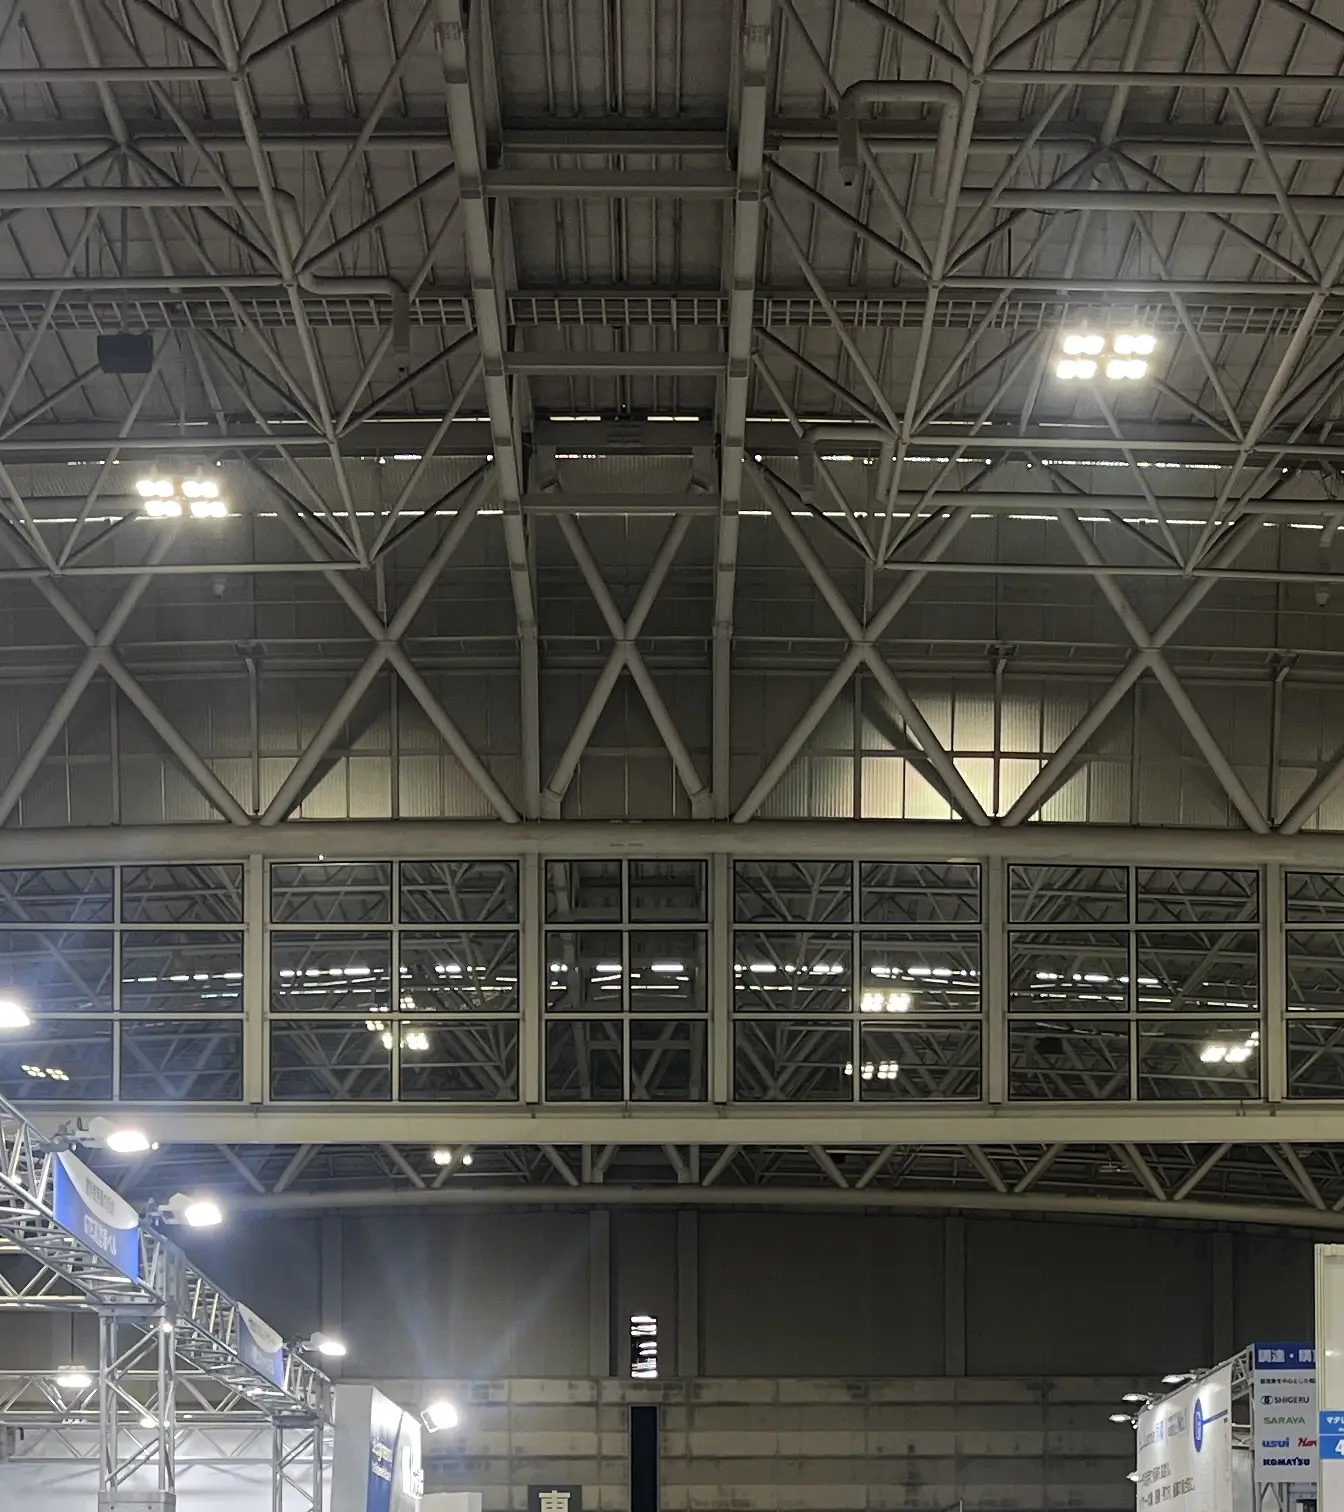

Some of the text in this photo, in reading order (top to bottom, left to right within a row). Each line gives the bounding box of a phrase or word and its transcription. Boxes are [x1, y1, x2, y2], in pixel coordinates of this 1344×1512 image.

[1274, 1396, 1310, 1404] SHIGERU
[1264, 1417, 1306, 1425] SARAYA
[1263, 1457, 1311, 1466] KOMATSU
